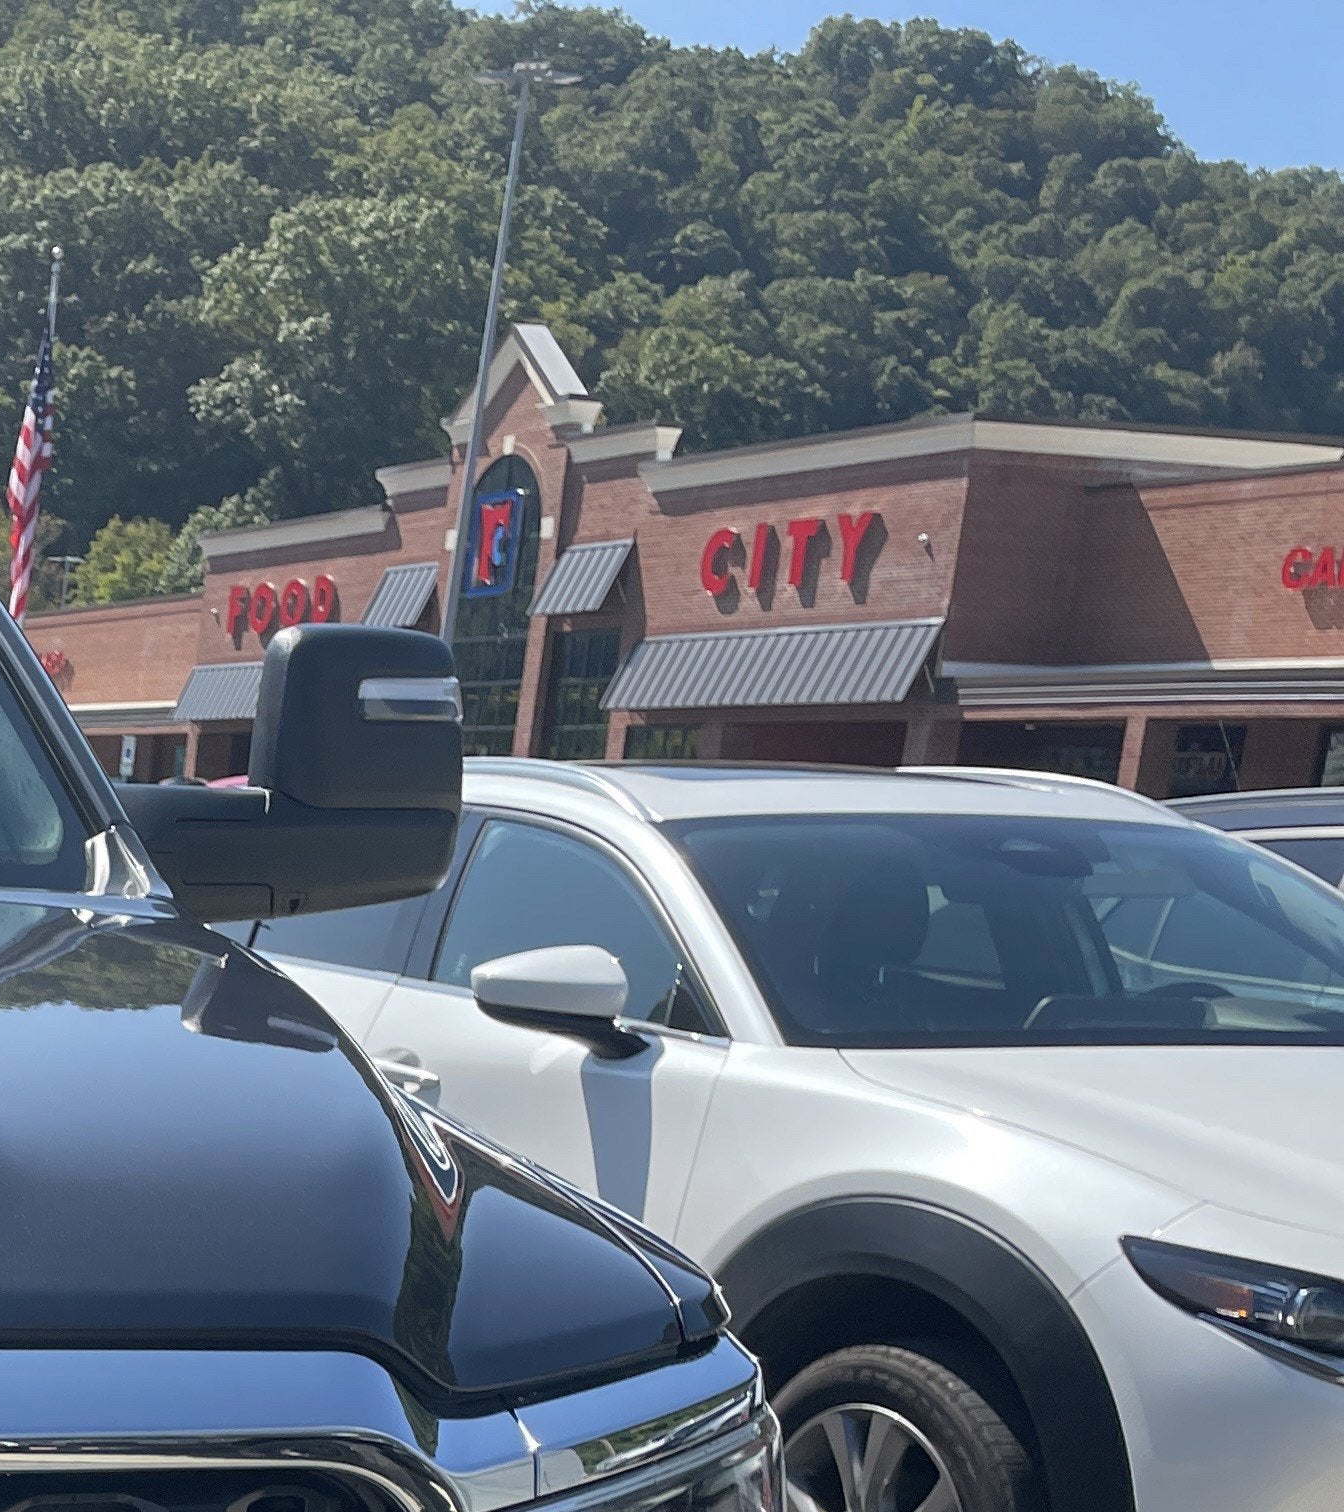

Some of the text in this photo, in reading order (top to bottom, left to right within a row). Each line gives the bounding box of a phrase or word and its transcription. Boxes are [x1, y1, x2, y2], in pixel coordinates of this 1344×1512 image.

[226, 511, 874, 635] FOOD CITY
[1281, 545, 1344, 591] CA
